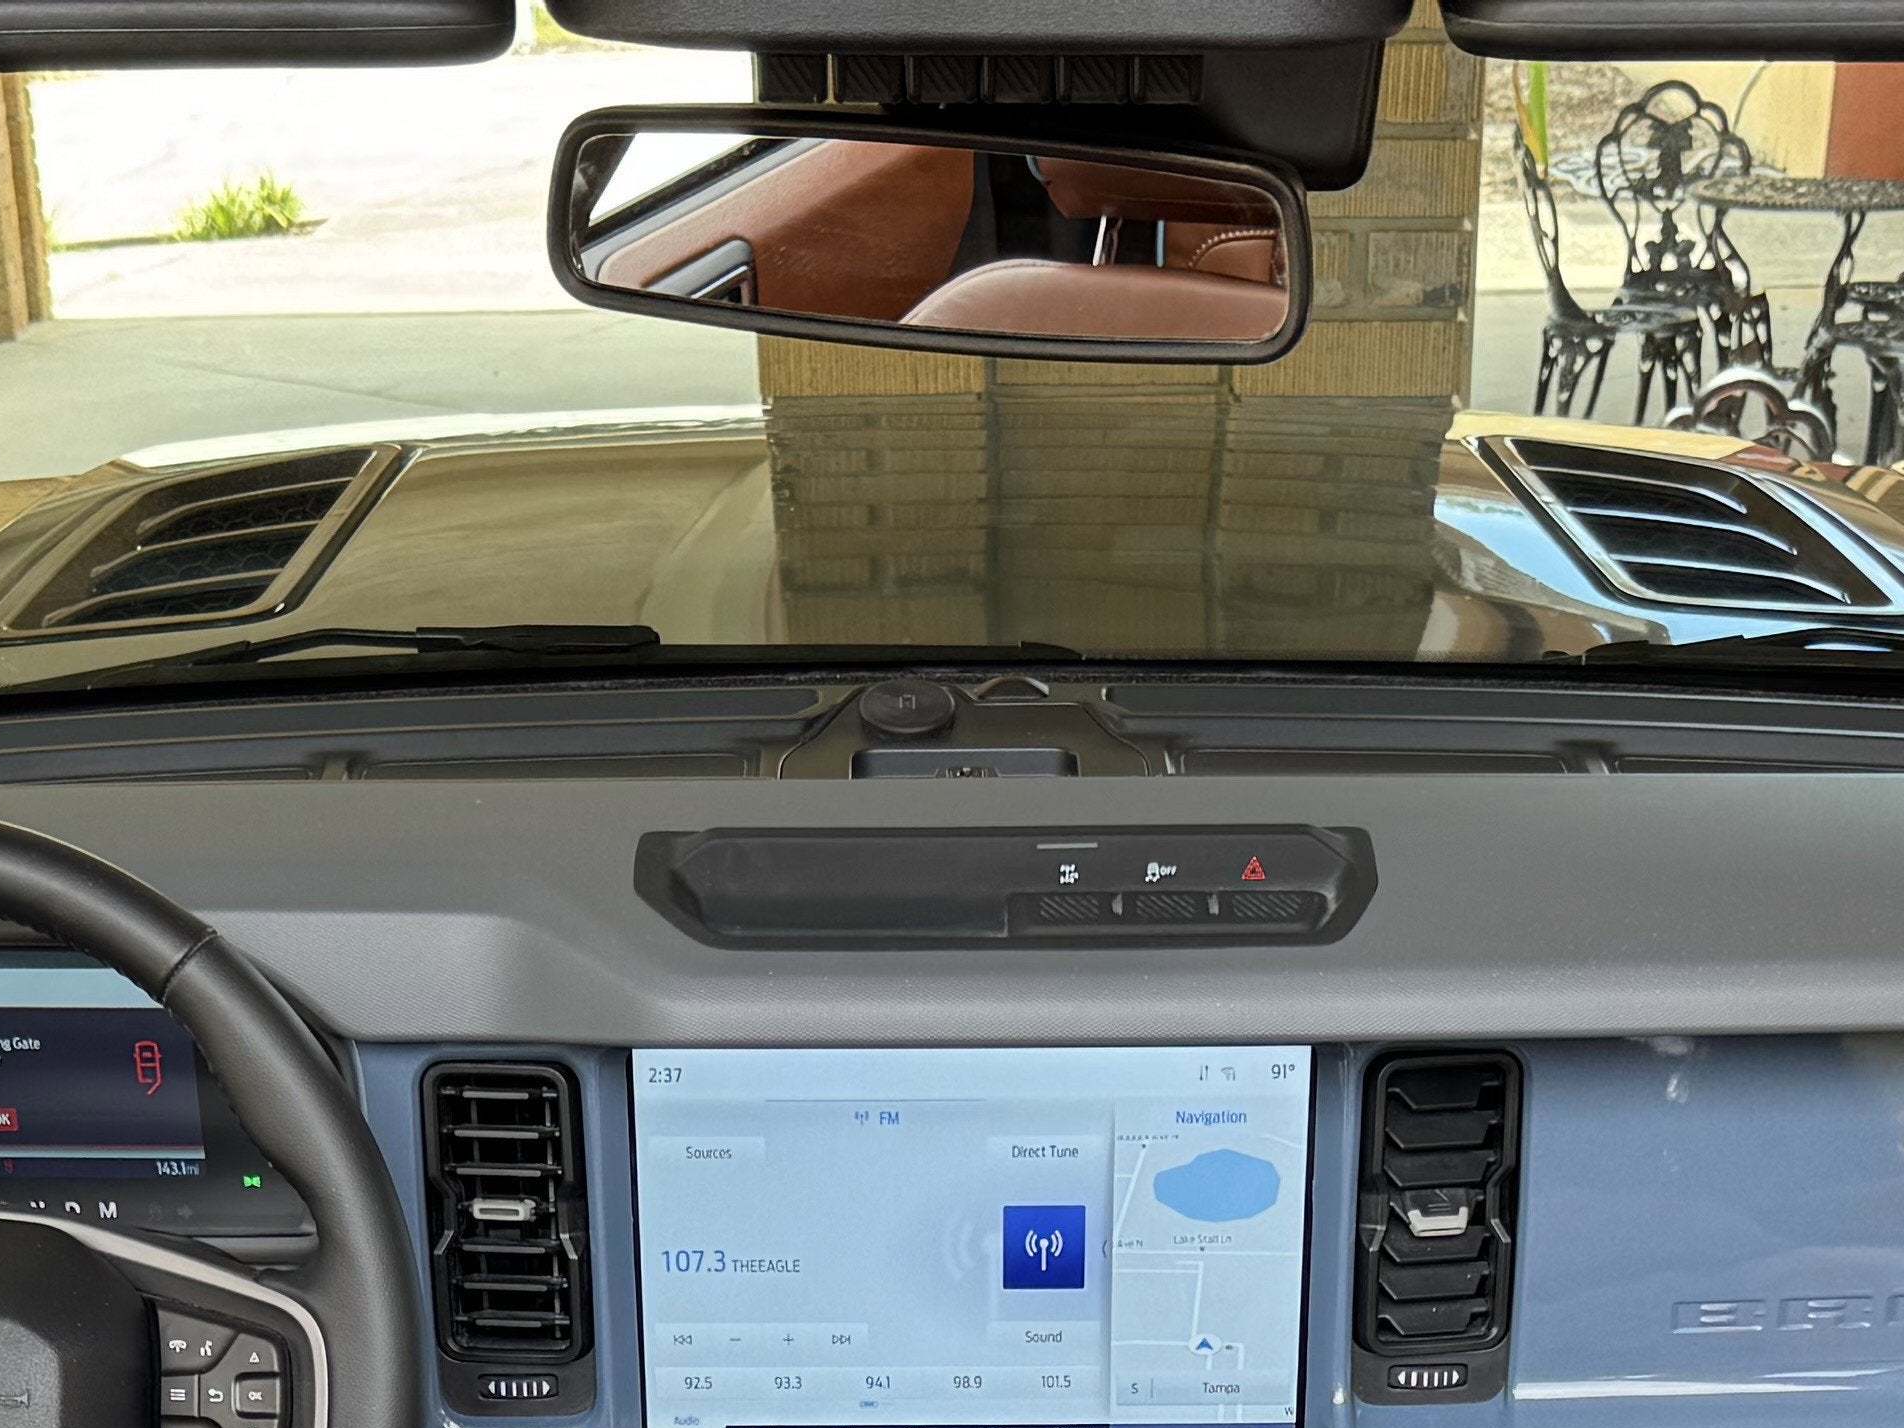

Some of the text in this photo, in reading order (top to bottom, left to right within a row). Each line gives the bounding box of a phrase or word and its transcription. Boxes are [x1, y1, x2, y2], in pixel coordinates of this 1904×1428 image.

[13, 1036, 41, 1051] Gate
[648, 1067, 682, 1084] 2:37
[879, 1111, 900, 1126] FM
[1176, 1109, 1247, 1126] Navigation
[685, 1145, 733, 1160] Sources
[1011, 1144, 1079, 1159] Direct Tune
[156, 1161, 186, 1176] 143.1
[660, 1249, 801, 1273] 107.3 THEEAGLE
[1025, 1330, 1063, 1343] Sound
[684, 1376, 713, 1390] 92.5
[774, 1375, 803, 1389] 93.3
[865, 1375, 891, 1389] 94.1
[953, 1375, 983, 1388] 98.9
[1041, 1374, 1072, 1388] 101.5
[1202, 1381, 1241, 1396] Tampa
[1130, 1383, 1139, 1395] S
[674, 1415, 700, 1426] Audio
